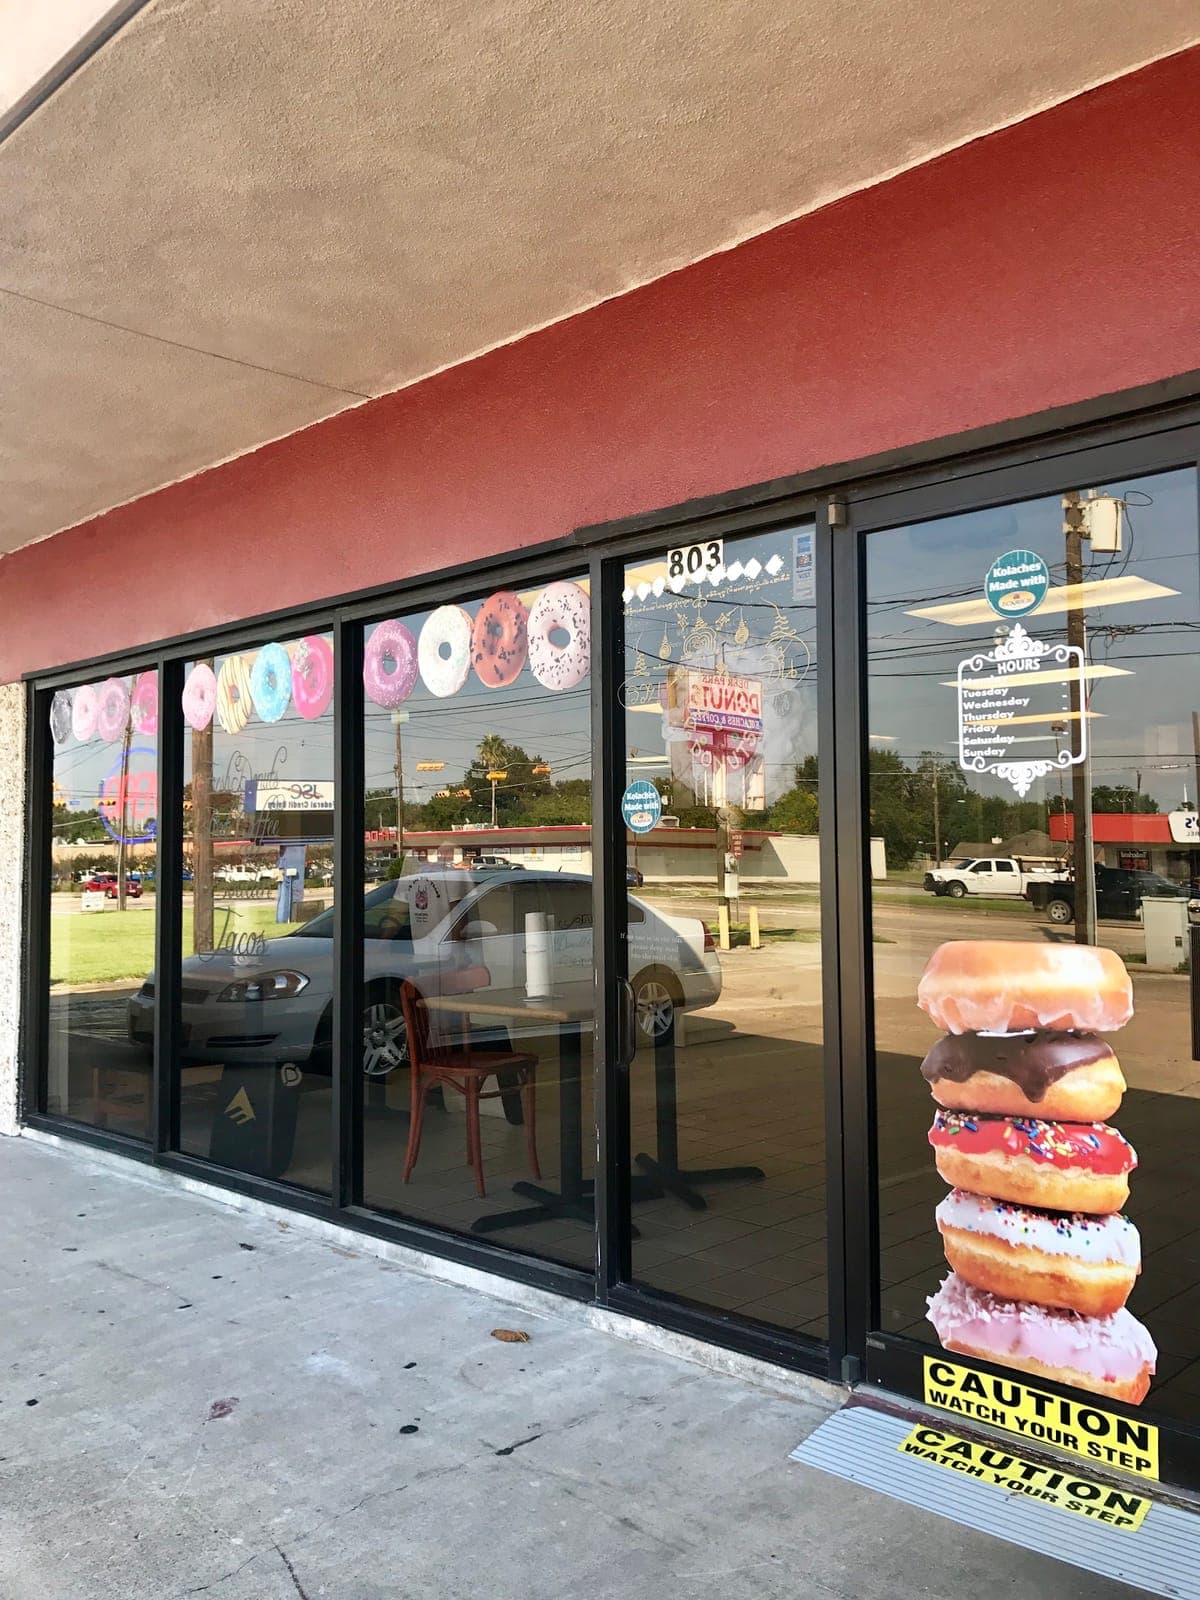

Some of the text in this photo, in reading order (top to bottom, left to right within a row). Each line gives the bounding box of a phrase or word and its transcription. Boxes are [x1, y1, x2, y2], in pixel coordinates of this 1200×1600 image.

[669, 542, 721, 578] 803
[993, 563, 1041, 577] Kolaches
[989, 575, 1046, 592] Made with
[997, 659, 1041, 674] HOURS
[963, 688, 1009, 698] Tuesday
[963, 697, 1030, 710] Wednesday
[963, 711, 1015, 722] Thursday
[963, 725, 998, 734] Friday
[963, 735, 1015, 745] Saturday
[963, 747, 1006, 757] Sunday
[627, 792, 656, 800] Kolaches
[624, 803, 643, 811] Made
[199, 906, 270, 956] Tacos
[929, 1363, 1149, 1451] CAUTION
[929, 1389, 1152, 1472] WATCH YOUR STEP
[916, 1430, 1142, 1516] CAUTION
[904, 1443, 1134, 1528] WATCH YOUR STEP
